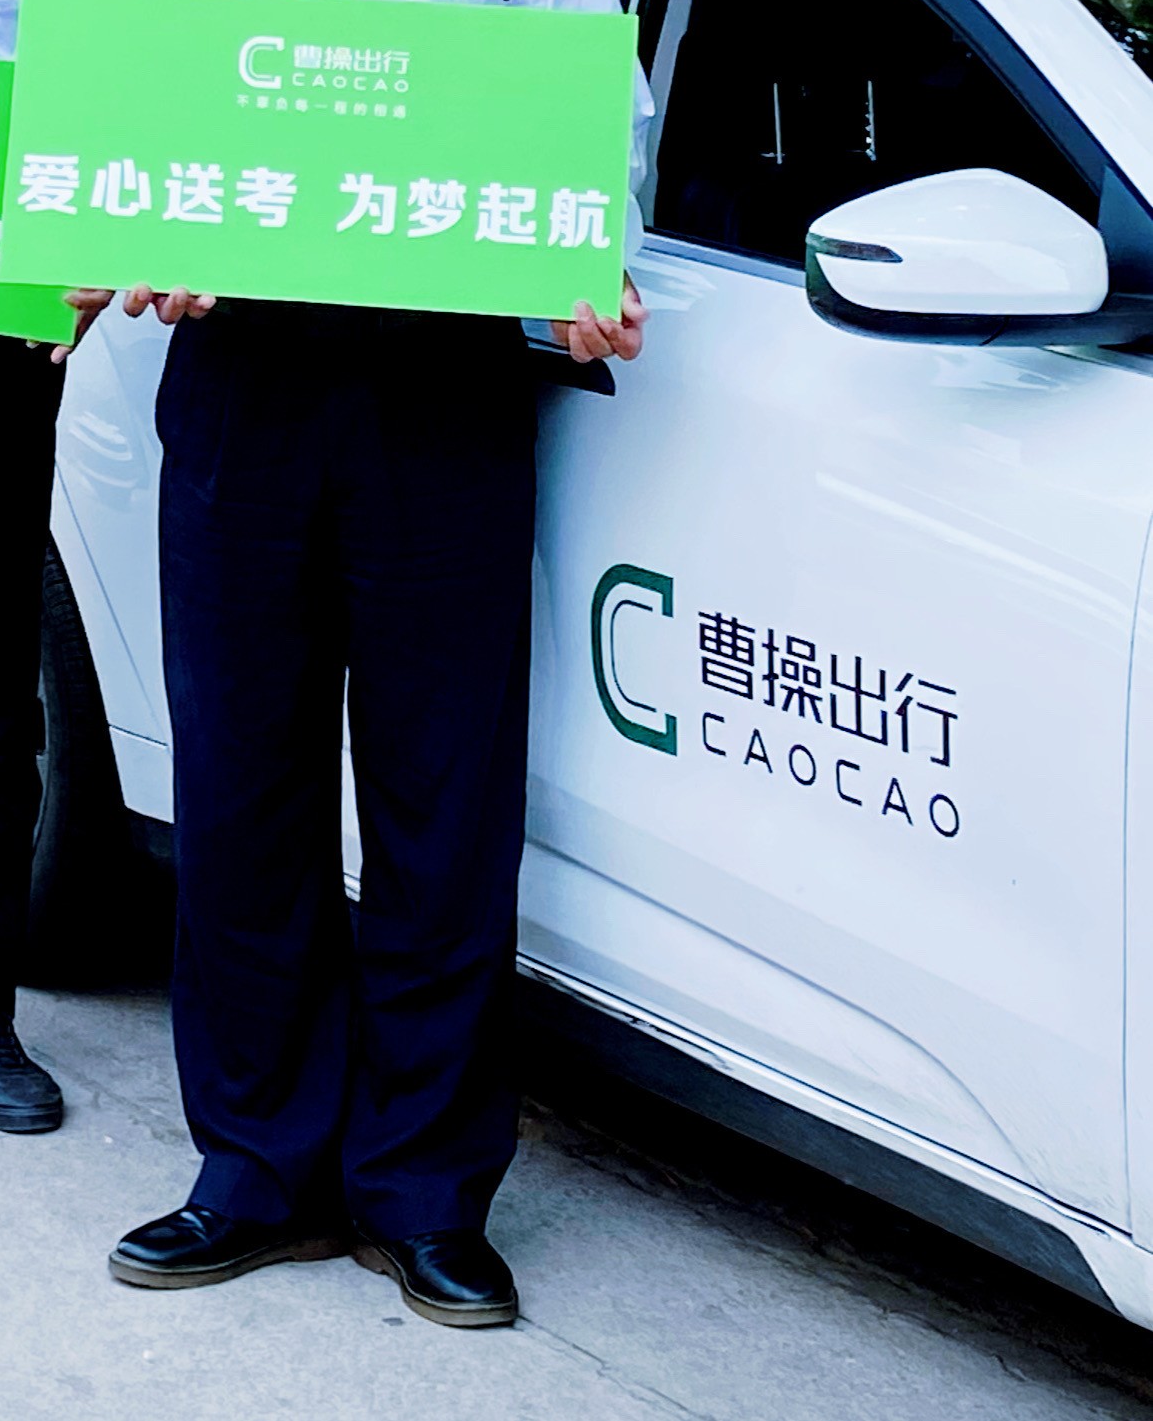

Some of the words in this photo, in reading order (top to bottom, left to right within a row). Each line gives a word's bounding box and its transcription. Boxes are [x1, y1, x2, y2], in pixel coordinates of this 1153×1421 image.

[292, 73, 409, 93] CAOCAO
[294, 44, 410, 75] 曹操出行
[18, 154, 297, 228] 爱心送考
[336, 173, 611, 250] 为梦起航
[698, 611, 958, 767] 曹操出行
[702, 712, 960, 837] CAOCAO
